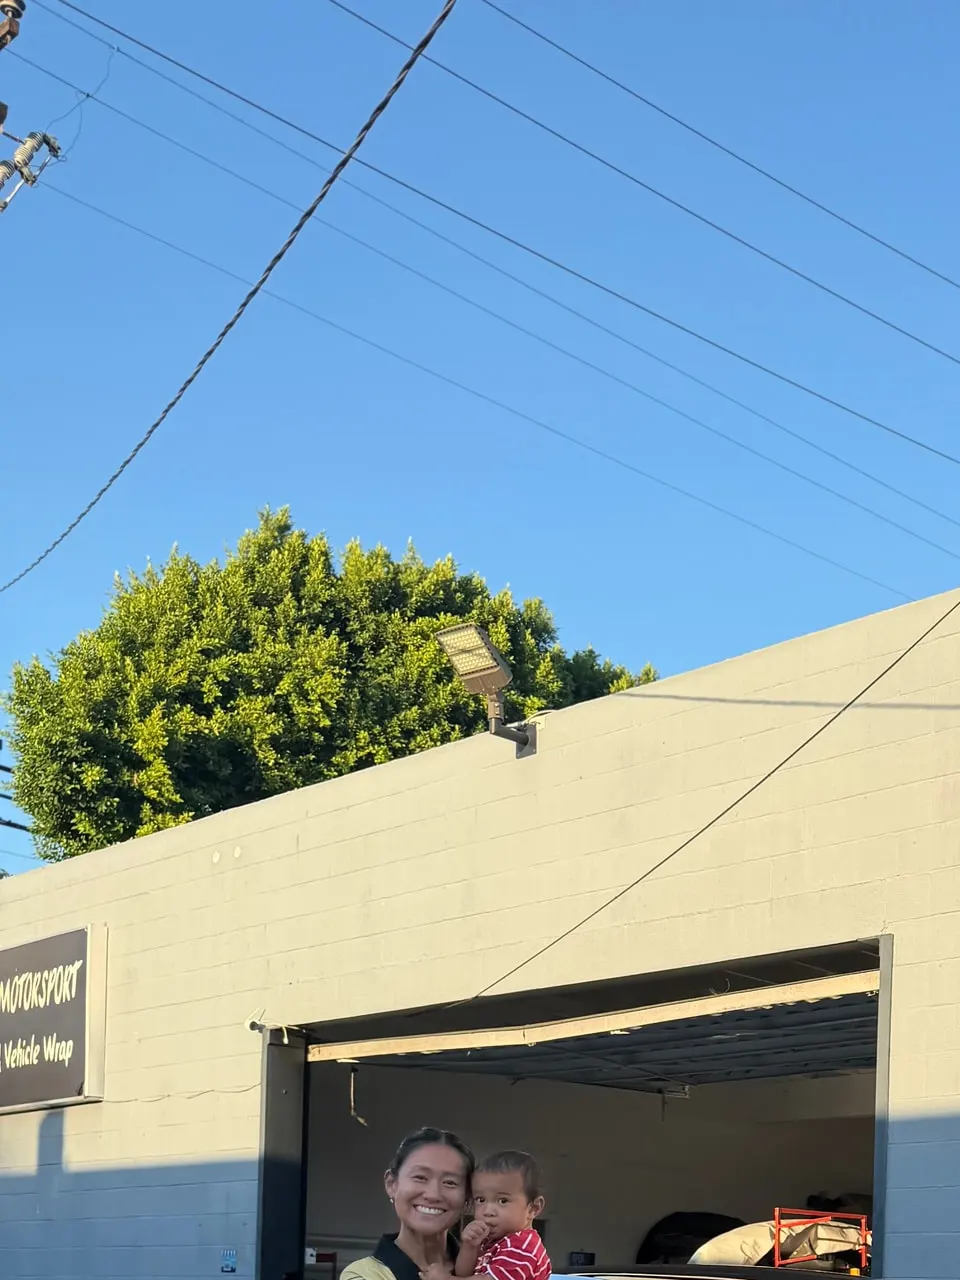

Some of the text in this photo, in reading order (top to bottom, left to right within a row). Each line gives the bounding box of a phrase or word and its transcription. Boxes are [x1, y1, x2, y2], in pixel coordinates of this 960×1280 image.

[0, 960, 83, 1014] MOTORSPORT
[4, 1034, 40, 1069] Vehicle
[43, 1032, 74, 1068] Wrap
